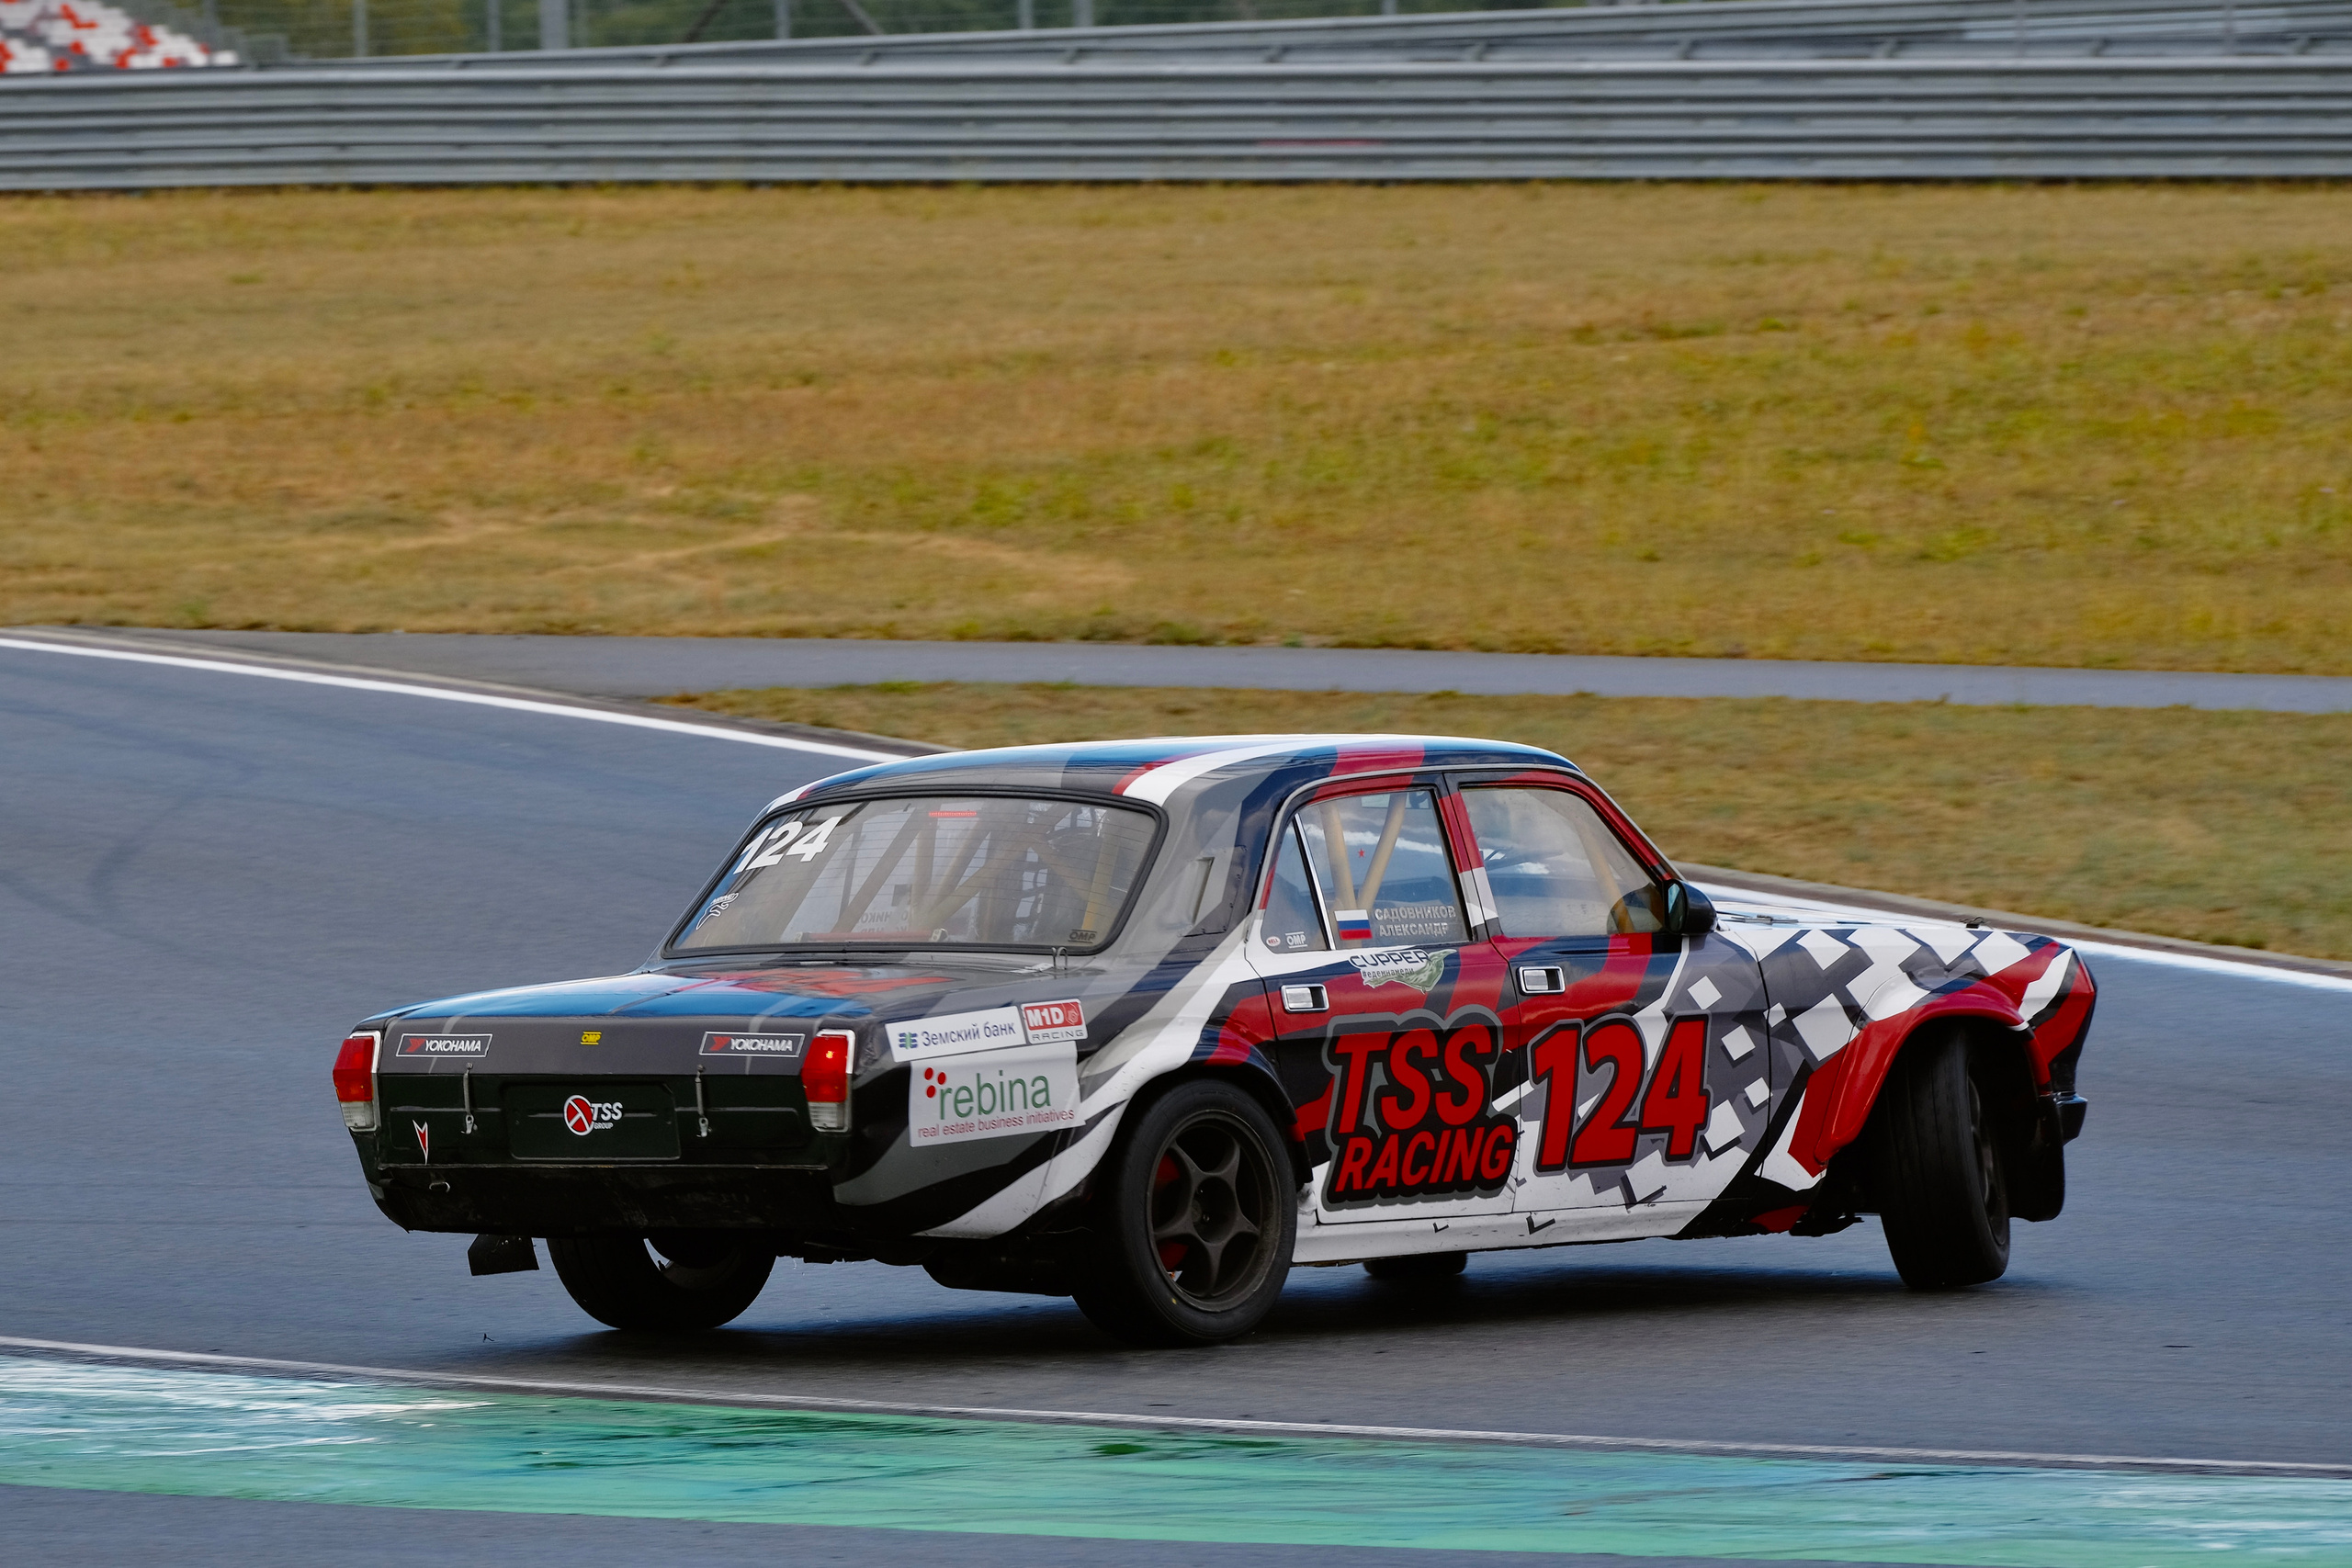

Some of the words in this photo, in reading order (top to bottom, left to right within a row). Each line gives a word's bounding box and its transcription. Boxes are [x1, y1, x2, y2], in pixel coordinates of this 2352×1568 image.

[733, 816, 842, 874] 124
[1374, 906, 1456, 922] САДОВНИКОВ
[1069, 931, 1096, 942] OMP
[1379, 922, 1448, 937] АЛЕКСАНДР
[1286, 934, 1306, 946] OMP
[1350, 950, 1432, 967] CUPPER
[1363, 967, 1414, 978] #едемнамеди
[1026, 1007, 1065, 1027] M1D
[582, 1033, 602, 1043] OMP
[922, 1022, 980, 1046] Земский
[983, 1021, 1016, 1038] банк
[1032, 1030, 1084, 1041] RACING
[425, 1040, 481, 1052] YOKOHAMA
[730, 1038, 792, 1052] YOKOHAMA
[1332, 1021, 1494, 1135] TSS
[939, 1070, 1051, 1120] rebina
[1529, 1018, 1710, 1168] 124
[590, 1102, 623, 1121] TSS
[594, 1122, 614, 1130] GROUP
[918, 1123, 940, 1138] real
[943, 1121, 976, 1135] estate
[978, 1115, 1024, 1131] business
[1026, 1109, 1075, 1125] initiatives
[1333, 1123, 1513, 1192] RACING
